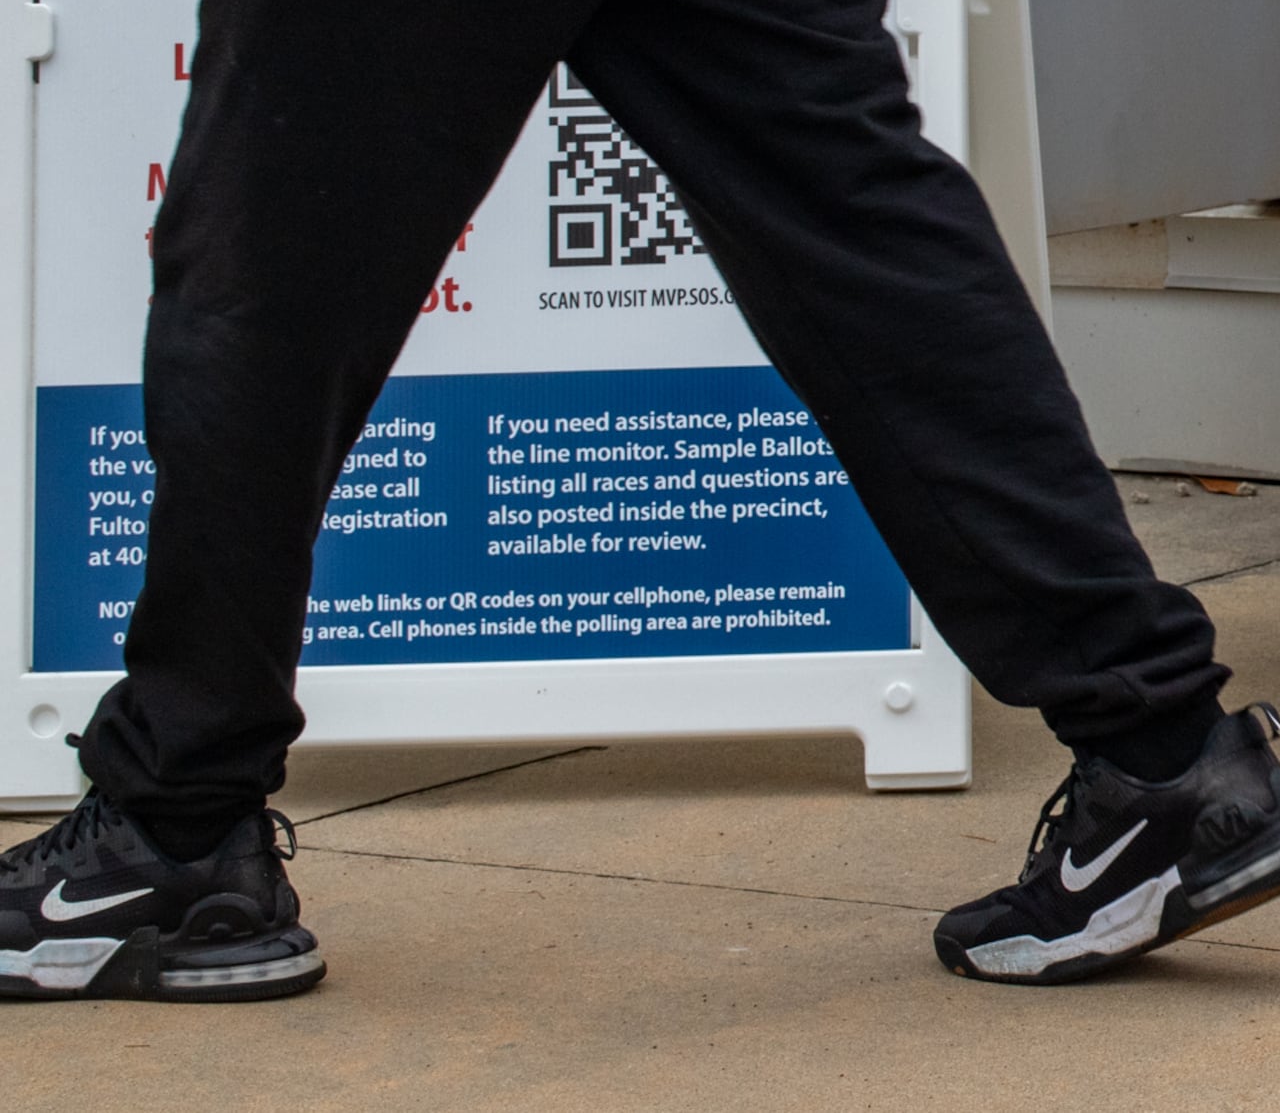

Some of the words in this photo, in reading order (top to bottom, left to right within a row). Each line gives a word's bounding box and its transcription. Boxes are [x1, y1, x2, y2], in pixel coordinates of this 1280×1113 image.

[538, 291, 580, 311] SCAN
[583, 290, 604, 309] TO
[606, 289, 648, 308] VISIT
[651, 288, 735, 307] MVP.SOS.G
[90, 425, 107, 446] If
[356, 417, 436, 443] arding
[488, 414, 505, 435] If
[508, 418, 549, 439] you
[555, 411, 610, 433] need
[615, 410, 732, 431] assistance,
[738, 407, 809, 432] please
[342, 447, 398, 474] gned
[403, 449, 427, 467] to
[487, 444, 525, 465] the
[530, 443, 571, 464] line
[576, 441, 669, 462] monitor.
[674, 437, 757, 463] Sample
[89, 455, 127, 476] the
[330, 483, 378, 500] ease
[382, 477, 420, 498] call
[488, 474, 556, 499] listing
[561, 472, 587, 493] all
[593, 476, 649, 492] races
[654, 469, 696, 490] and
[701, 467, 810, 493] questions
[814, 470, 849, 486] are
[89, 490, 137, 511] you,
[487, 504, 533, 525] also
[538, 501, 613, 529] posted
[619, 500, 685, 521] inside
[690, 499, 727, 519] the
[732, 497, 828, 523] precinct,
[89, 515, 146, 536] Fulto
[487, 533, 587, 556] available
[591, 532, 624, 552] for
[628, 531, 706, 551] review.
[88, 548, 111, 567] at
[306, 595, 331, 613] he
[333, 594, 374, 613] web
[377, 593, 422, 612] links
[425, 597, 447, 610] or
[449, 592, 477, 611] QR
[481, 590, 535, 609] codes
[538, 593, 563, 607] on
[567, 592, 610, 610] your
[613, 586, 711, 608] cellphone,
[715, 584, 776, 606] please
[779, 581, 846, 600] remain
[317, 625, 365, 640] area.
[368, 620, 403, 638] Cell
[407, 619, 477, 642] phones
[480, 616, 537, 635] inside
[540, 615, 573, 634] the
[576, 614, 642, 637] polling
[646, 616, 688, 631] area
[691, 615, 722, 629] are
[726, 608, 831, 633] prohibited.
